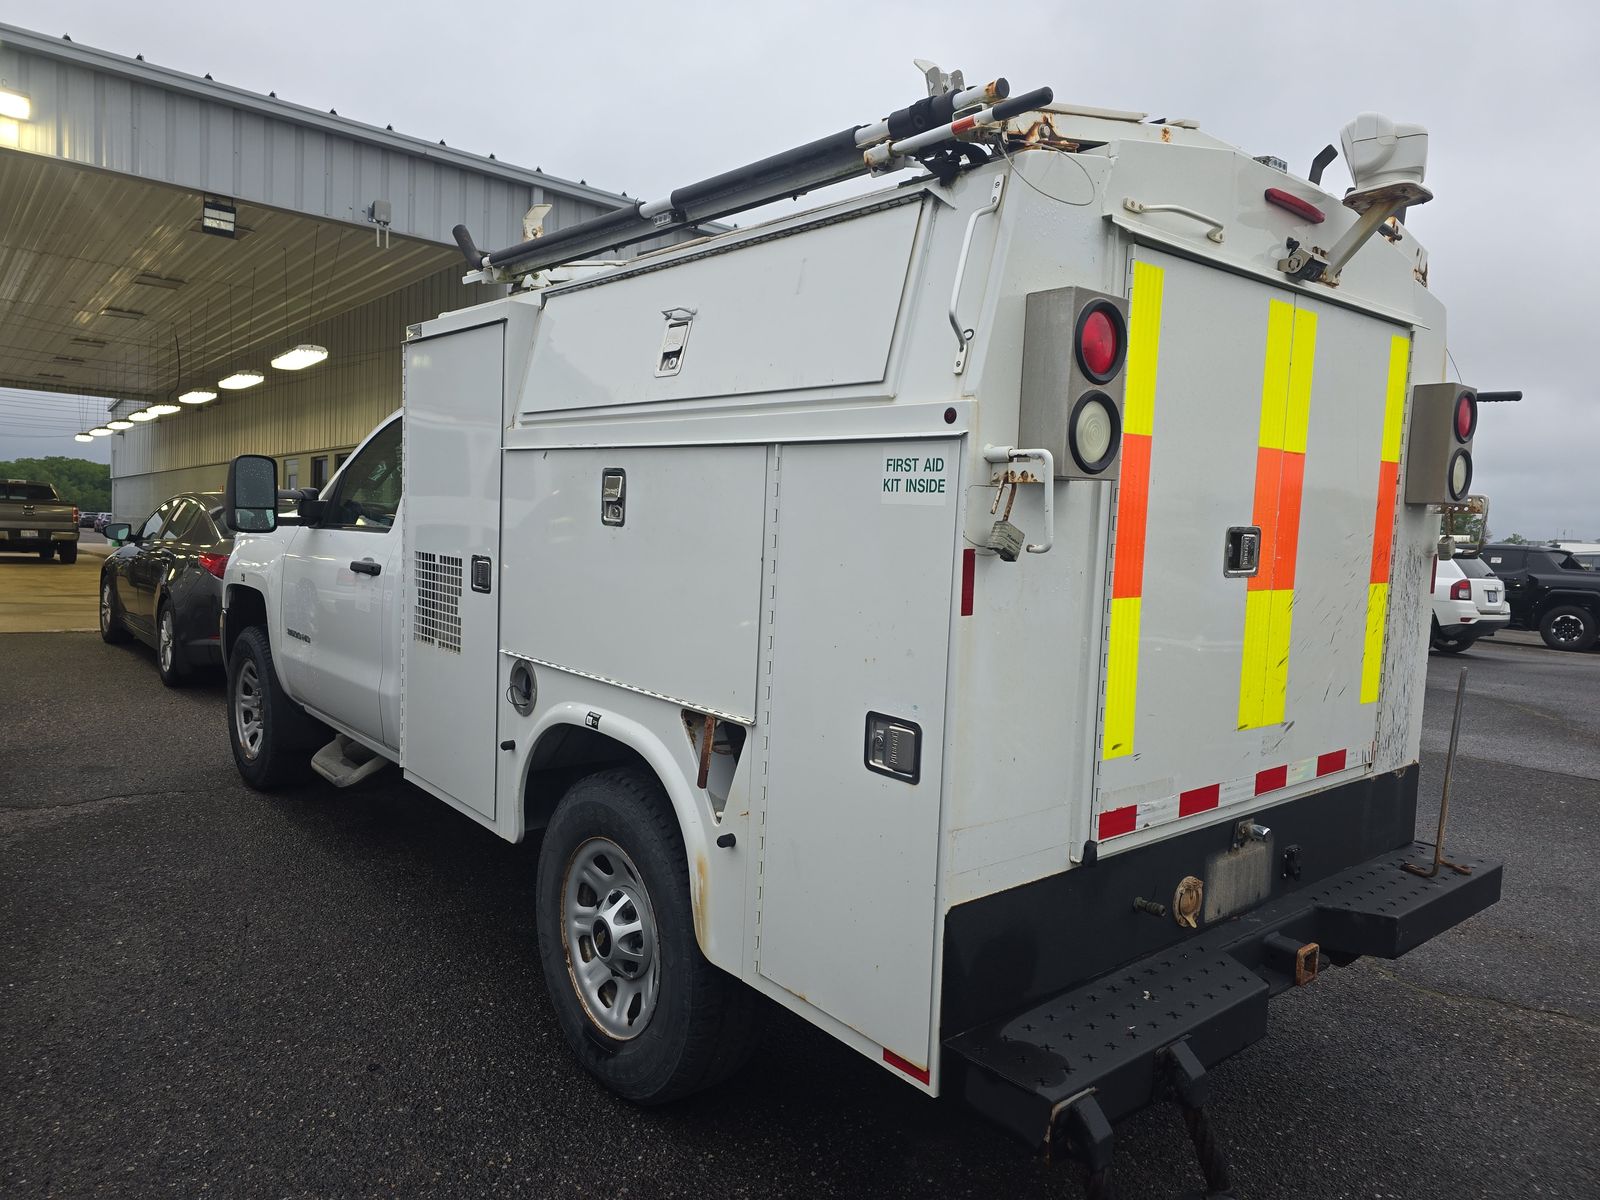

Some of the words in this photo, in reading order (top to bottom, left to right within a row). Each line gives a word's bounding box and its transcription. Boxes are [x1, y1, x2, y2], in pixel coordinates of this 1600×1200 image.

[886, 458, 919, 472] FIRST
[923, 457, 944, 472] AID
[883, 478, 901, 492] KIT
[905, 478, 946, 493] INSIDE
